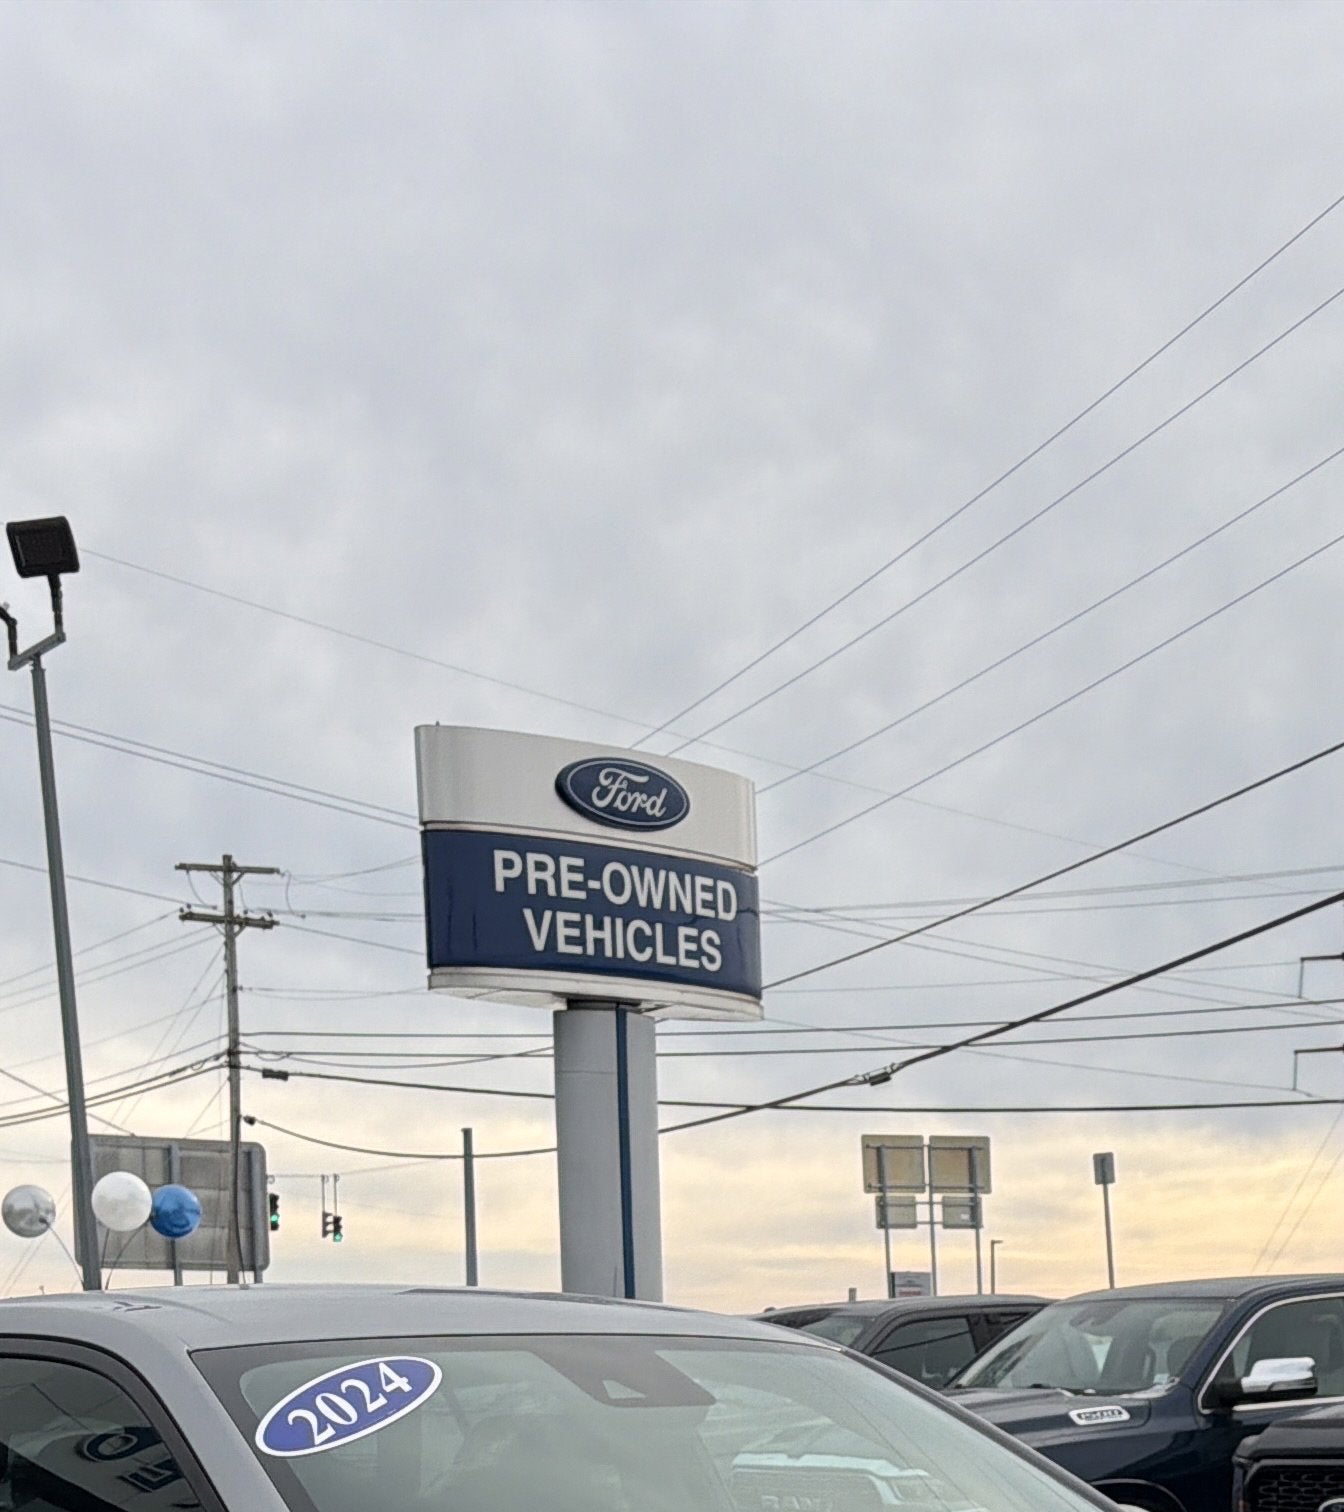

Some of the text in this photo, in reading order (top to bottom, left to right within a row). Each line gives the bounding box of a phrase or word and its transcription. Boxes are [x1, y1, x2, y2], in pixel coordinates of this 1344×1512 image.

[591, 767, 668, 818] Ford
[493, 849, 737, 922] PRE-OWNED
[523, 908, 722, 972] VEHICLES
[287, 1362, 413, 1445] 2024
